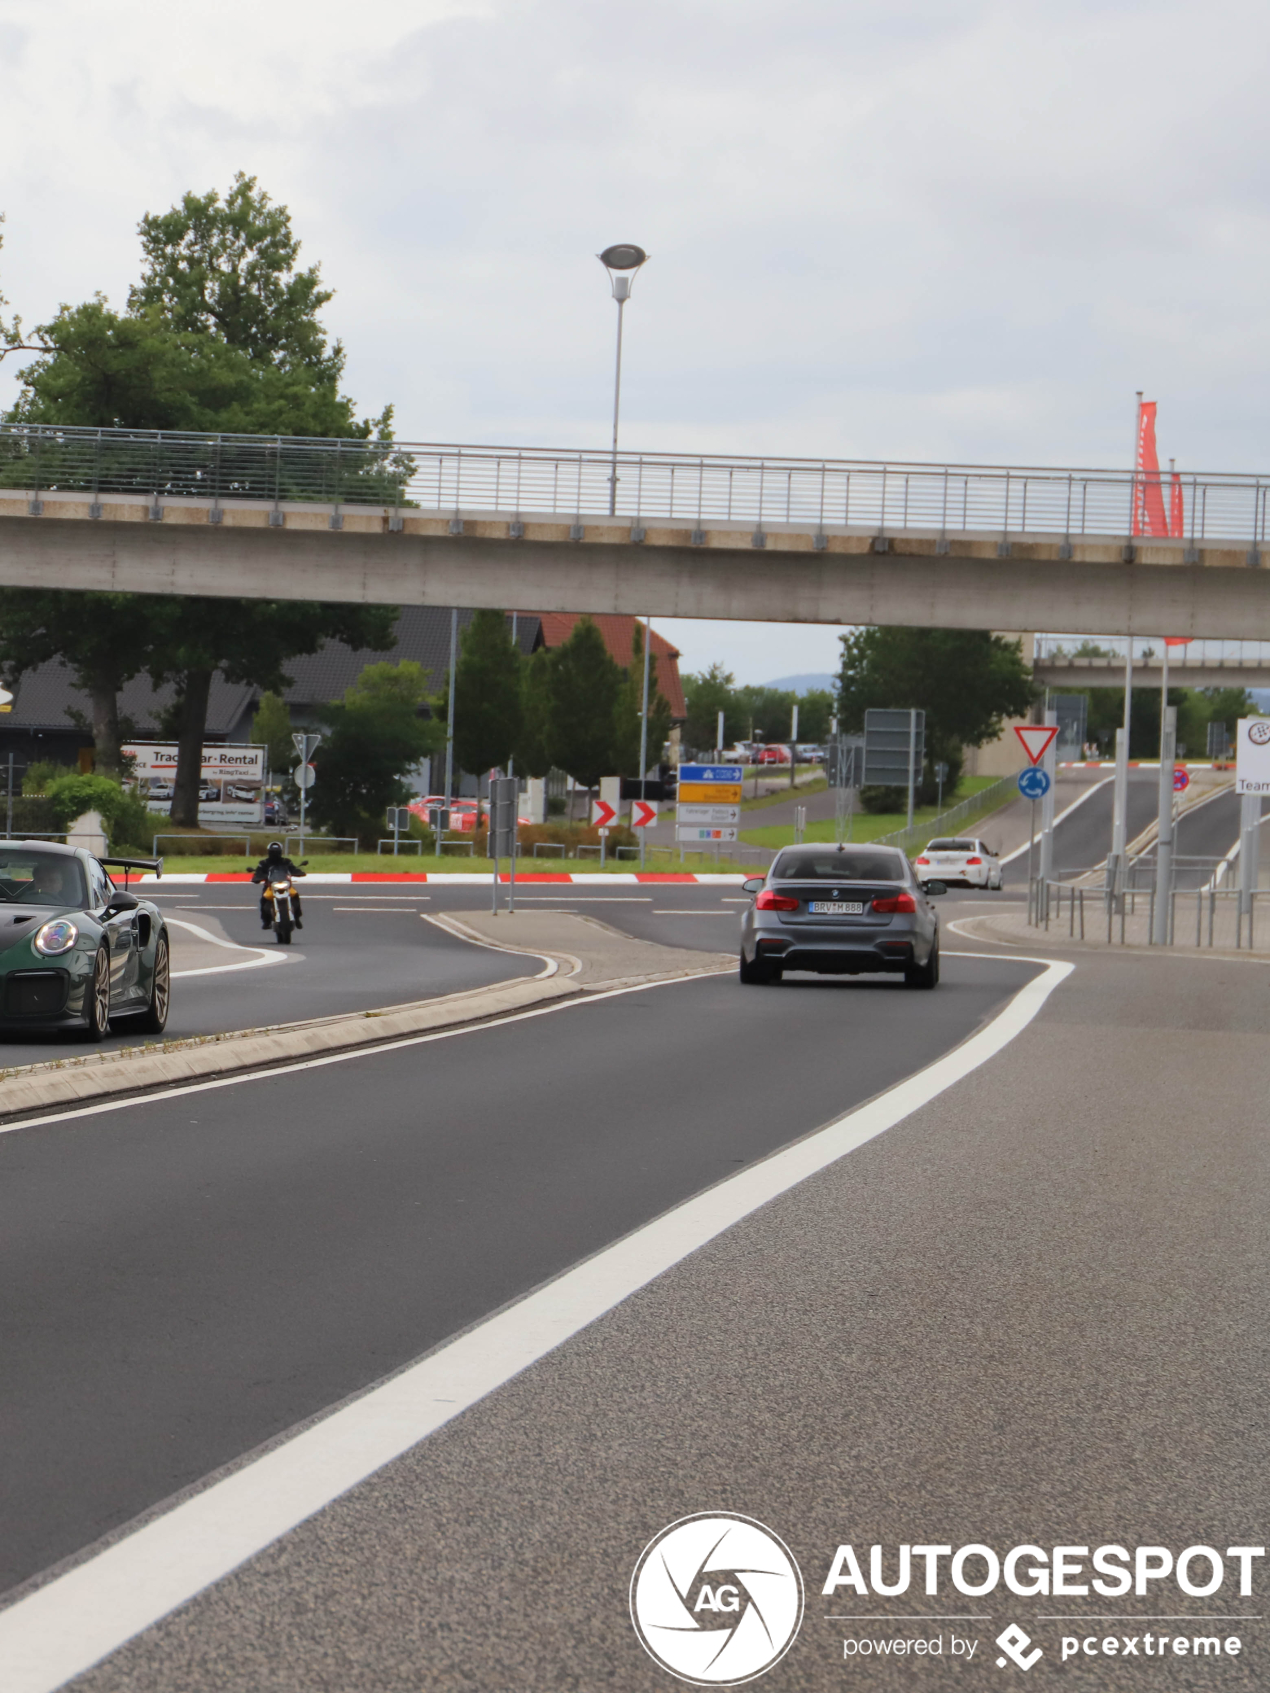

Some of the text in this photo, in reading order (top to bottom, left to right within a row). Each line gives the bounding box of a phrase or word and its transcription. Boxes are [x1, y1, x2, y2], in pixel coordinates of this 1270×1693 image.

[153, 751, 258, 765] Trac ar Rental
[837, 903, 844, 912] M
